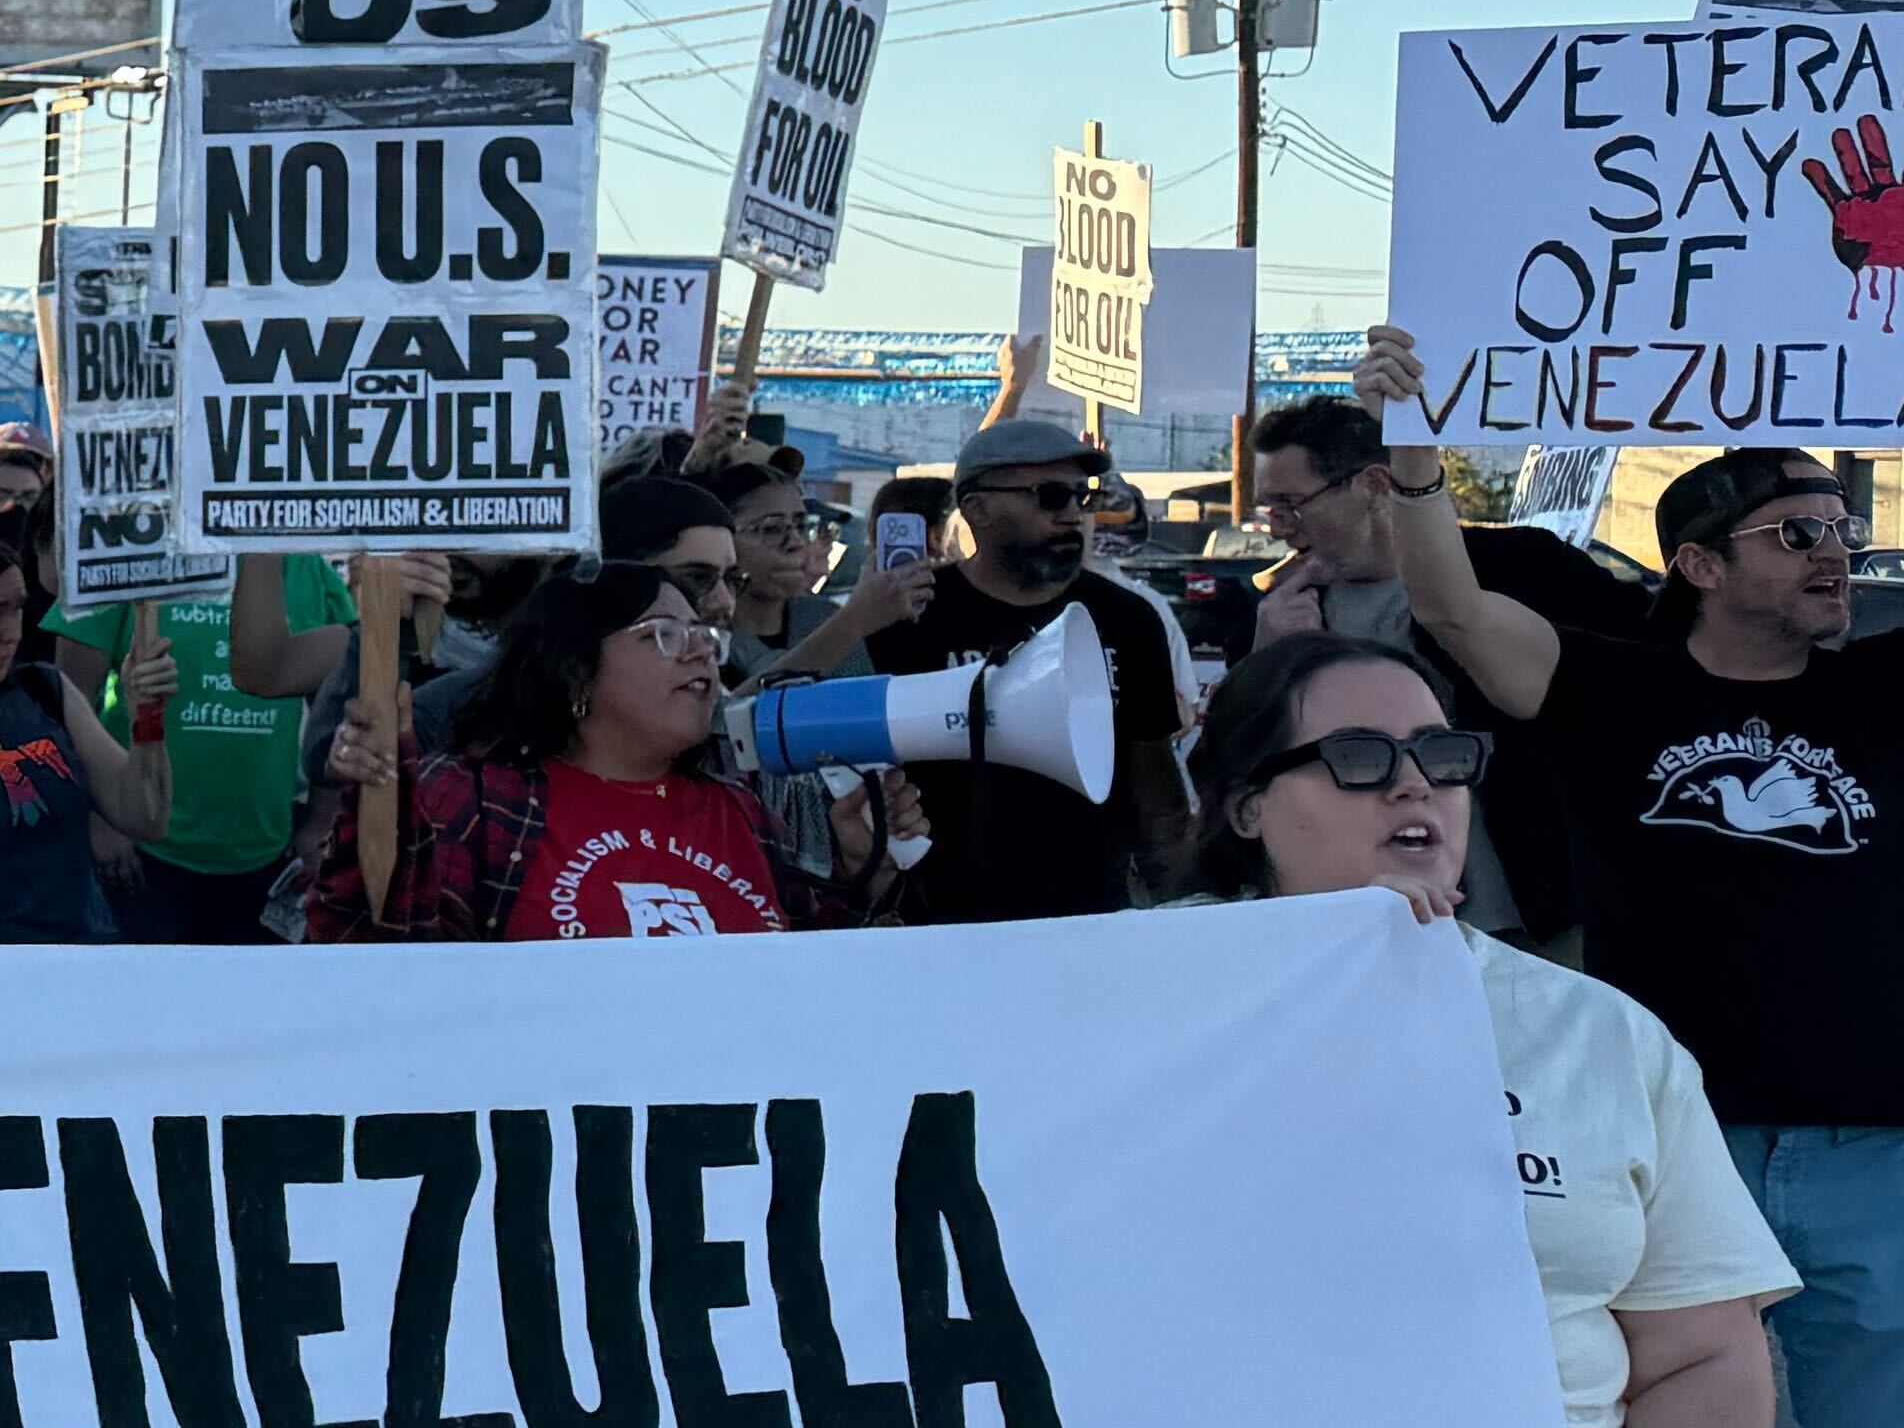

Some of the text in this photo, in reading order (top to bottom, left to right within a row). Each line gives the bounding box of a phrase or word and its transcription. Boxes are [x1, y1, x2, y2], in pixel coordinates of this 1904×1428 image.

[751, 98, 851, 216] FOR OIL
[1066, 161, 1117, 202] NO
[1589, 128, 1799, 232] SAY
[204, 141, 350, 288] NO
[374, 135, 572, 283] U.S.
[1096, 291, 1137, 361] OIL
[1515, 236, 1749, 343] OFF
[201, 314, 572, 385] WAR
[353, 374, 418, 395] ON
[607, 375, 696, 399] CAN'T
[1418, 342, 1904, 435] VENEZUEL
[202, 390, 572, 483] VENEZUELA
[629, 400, 683, 423] THE
[208, 497, 564, 528] PARTY FOR SOCIALISM & LIBERATION
[550, 829, 630, 939] SOCIALISM
[639, 828, 657, 850] &
